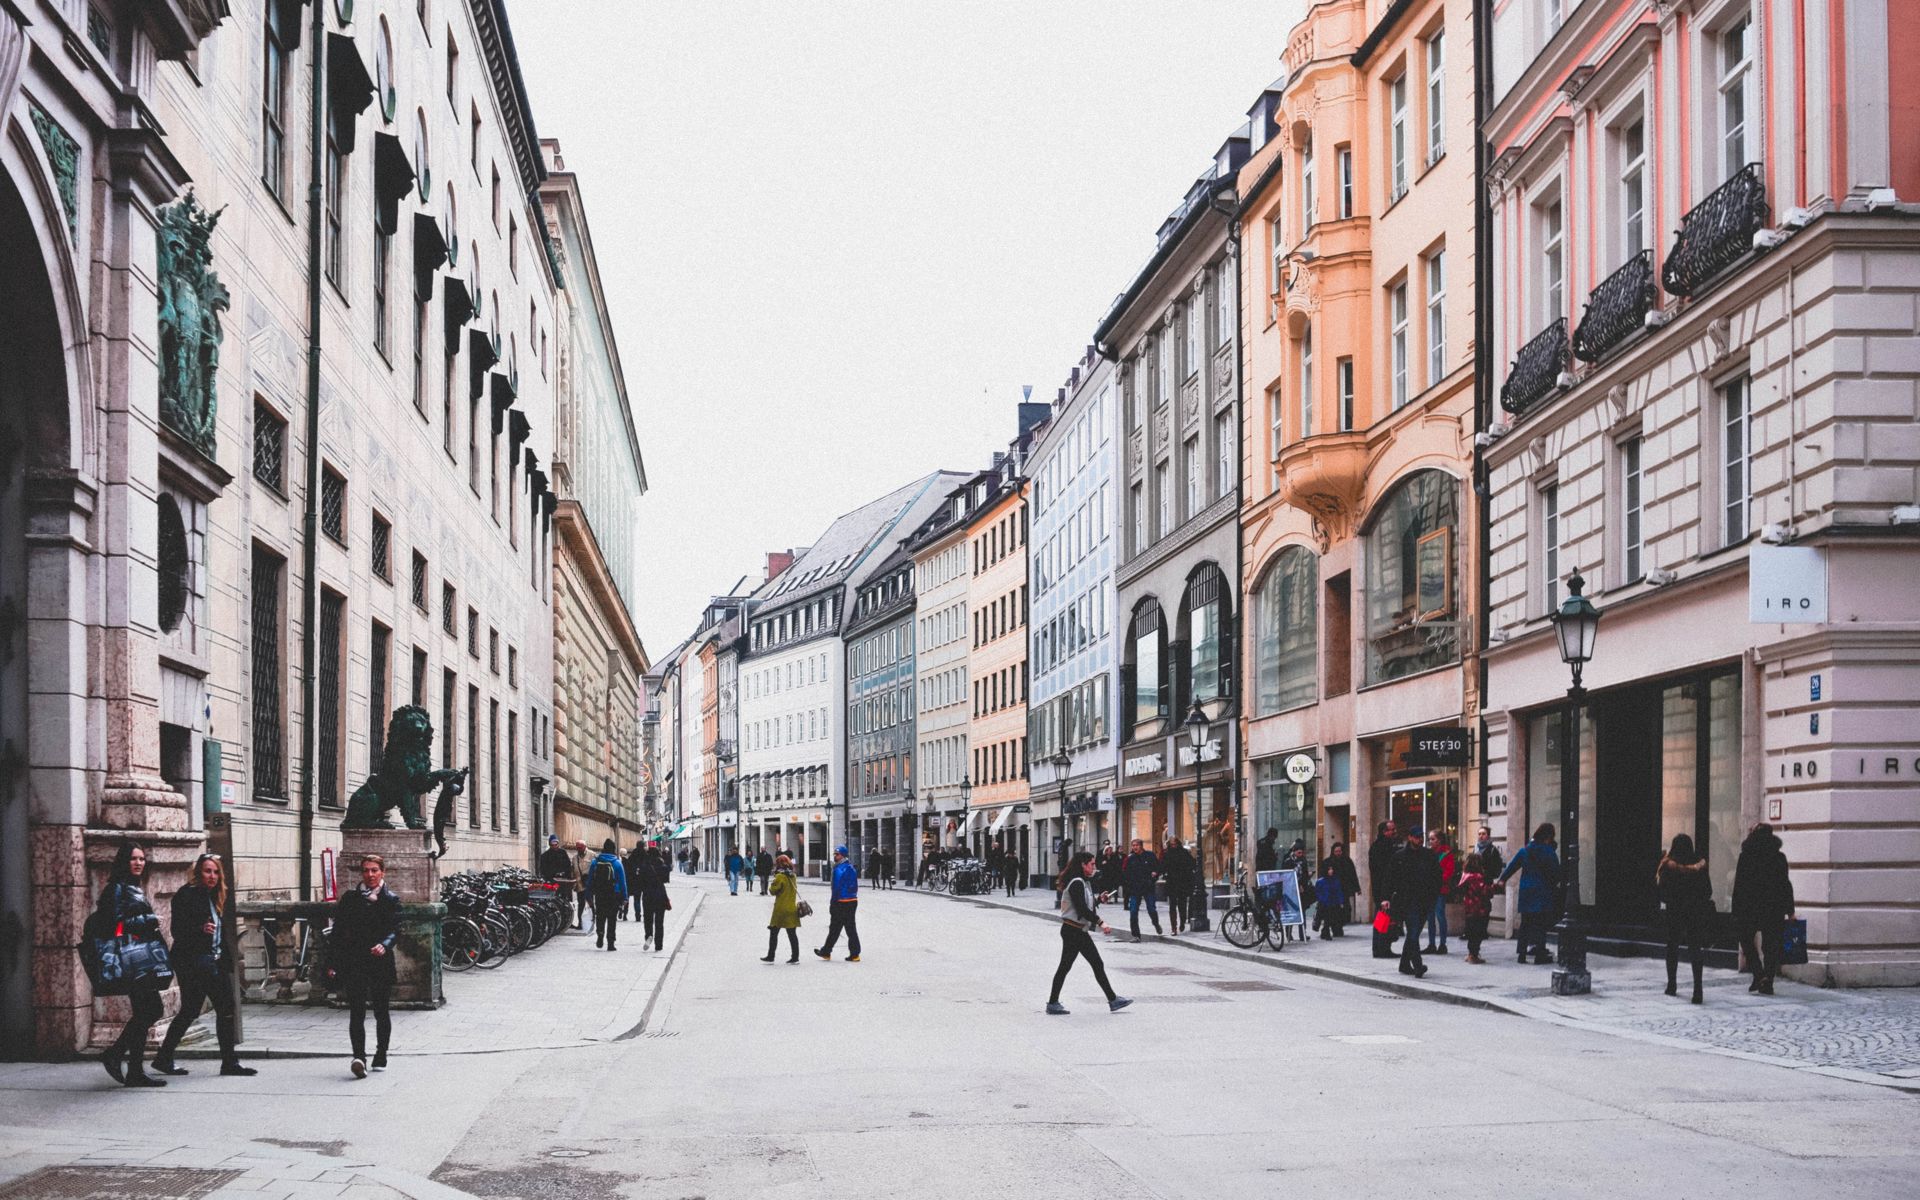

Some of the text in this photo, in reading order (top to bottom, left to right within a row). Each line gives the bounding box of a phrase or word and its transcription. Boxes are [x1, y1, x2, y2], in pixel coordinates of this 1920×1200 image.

[1767, 598, 1810, 609] IRO
[1781, 760, 1817, 778] IRO
[1490, 795, 1507, 807] IRO
